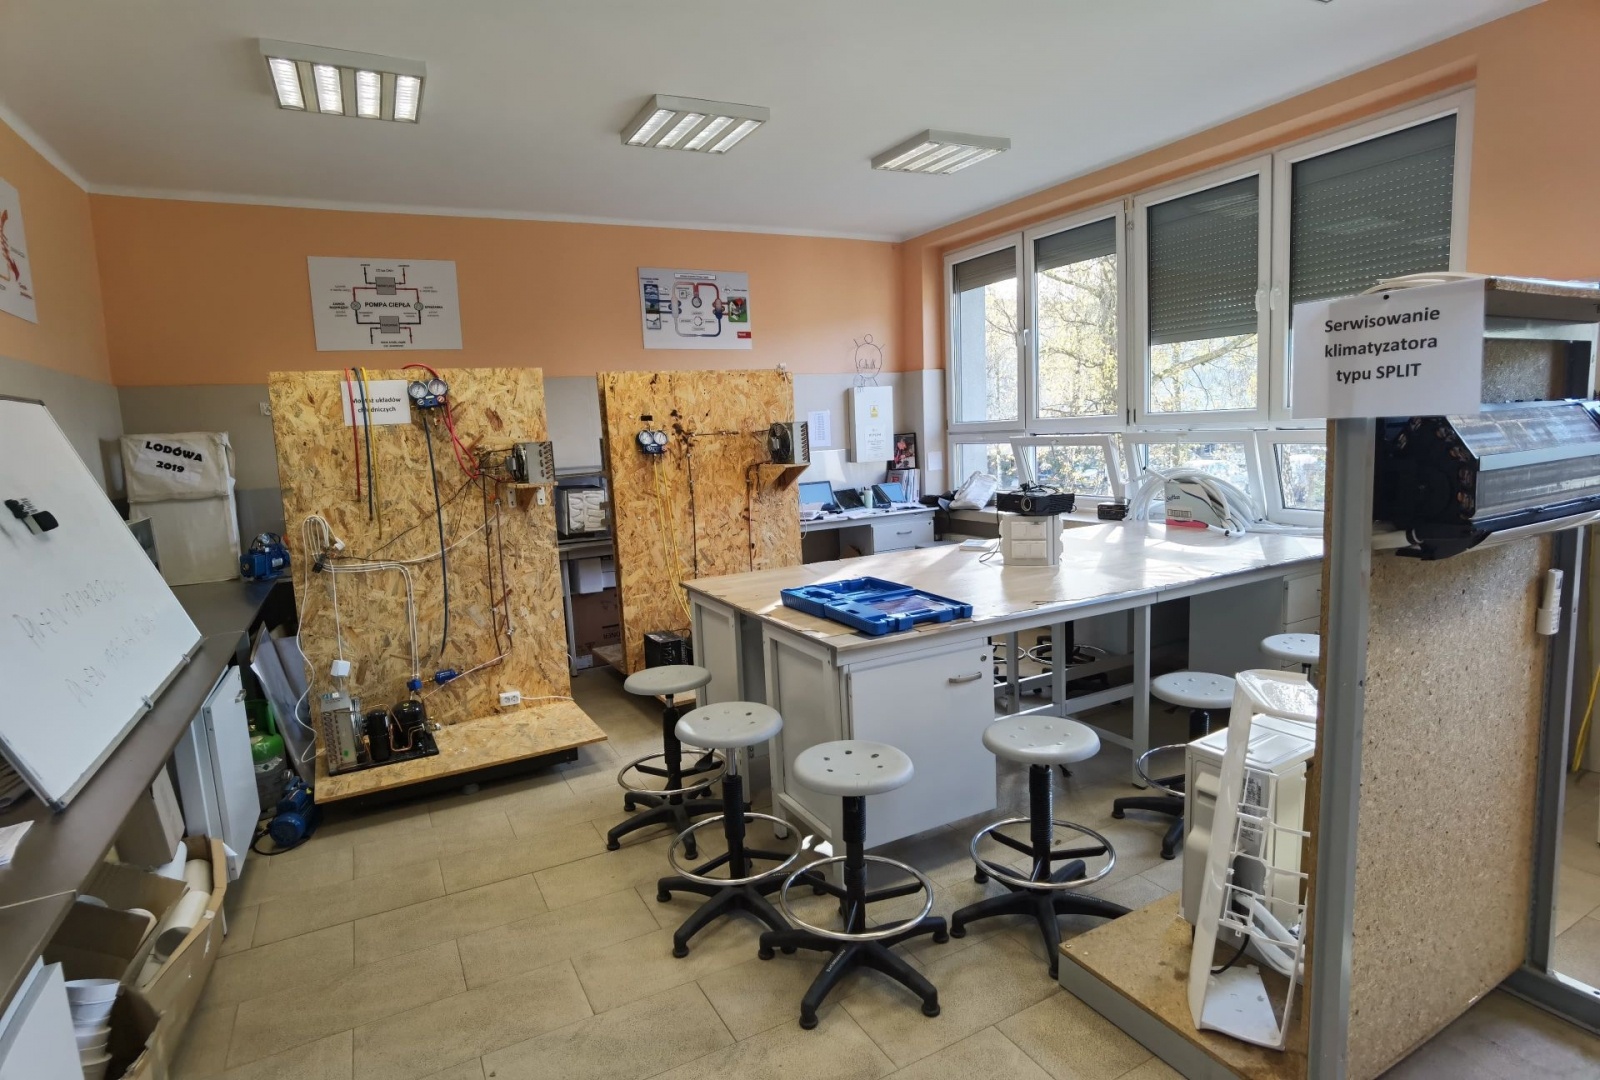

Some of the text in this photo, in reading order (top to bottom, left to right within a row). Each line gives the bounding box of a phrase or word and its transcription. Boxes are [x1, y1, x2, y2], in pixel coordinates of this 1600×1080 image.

[1324, 306, 1441, 333] Serwisowanie
[1324, 336, 1438, 358] klimatyzatora
[1336, 363, 1422, 385] typu SPLIT
[375, 396, 402, 404] układów
[145, 441, 203, 462] LODÓWA
[155, 460, 185, 473] 2019
